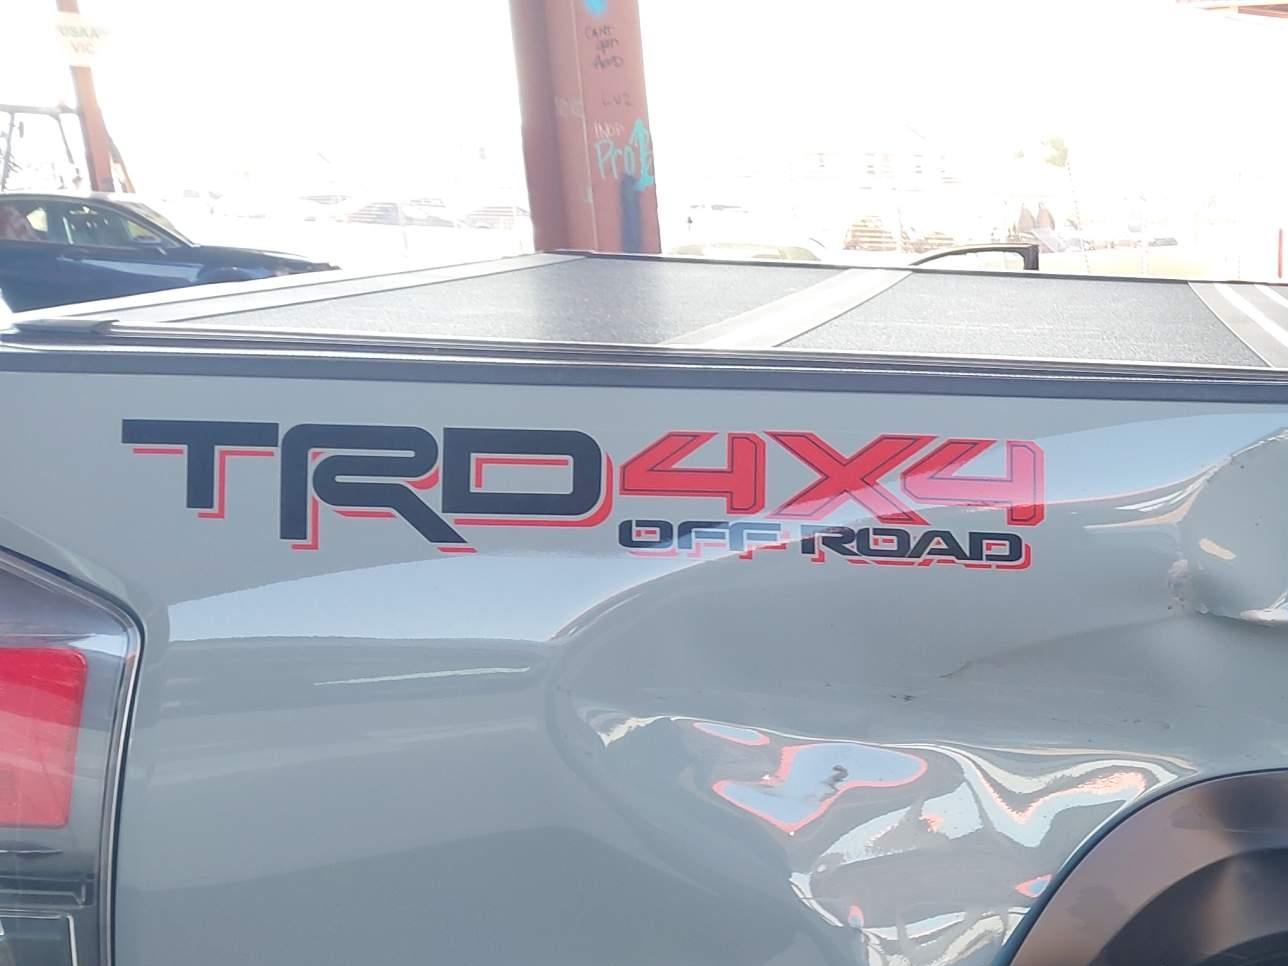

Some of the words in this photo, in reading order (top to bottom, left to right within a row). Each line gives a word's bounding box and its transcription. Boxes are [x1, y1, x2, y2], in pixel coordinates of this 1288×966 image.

[121, 418, 614, 554] TRD
[618, 430, 1046, 528] 4X4
[617, 518, 788, 561] OFF
[799, 525, 1033, 571] ROAD
